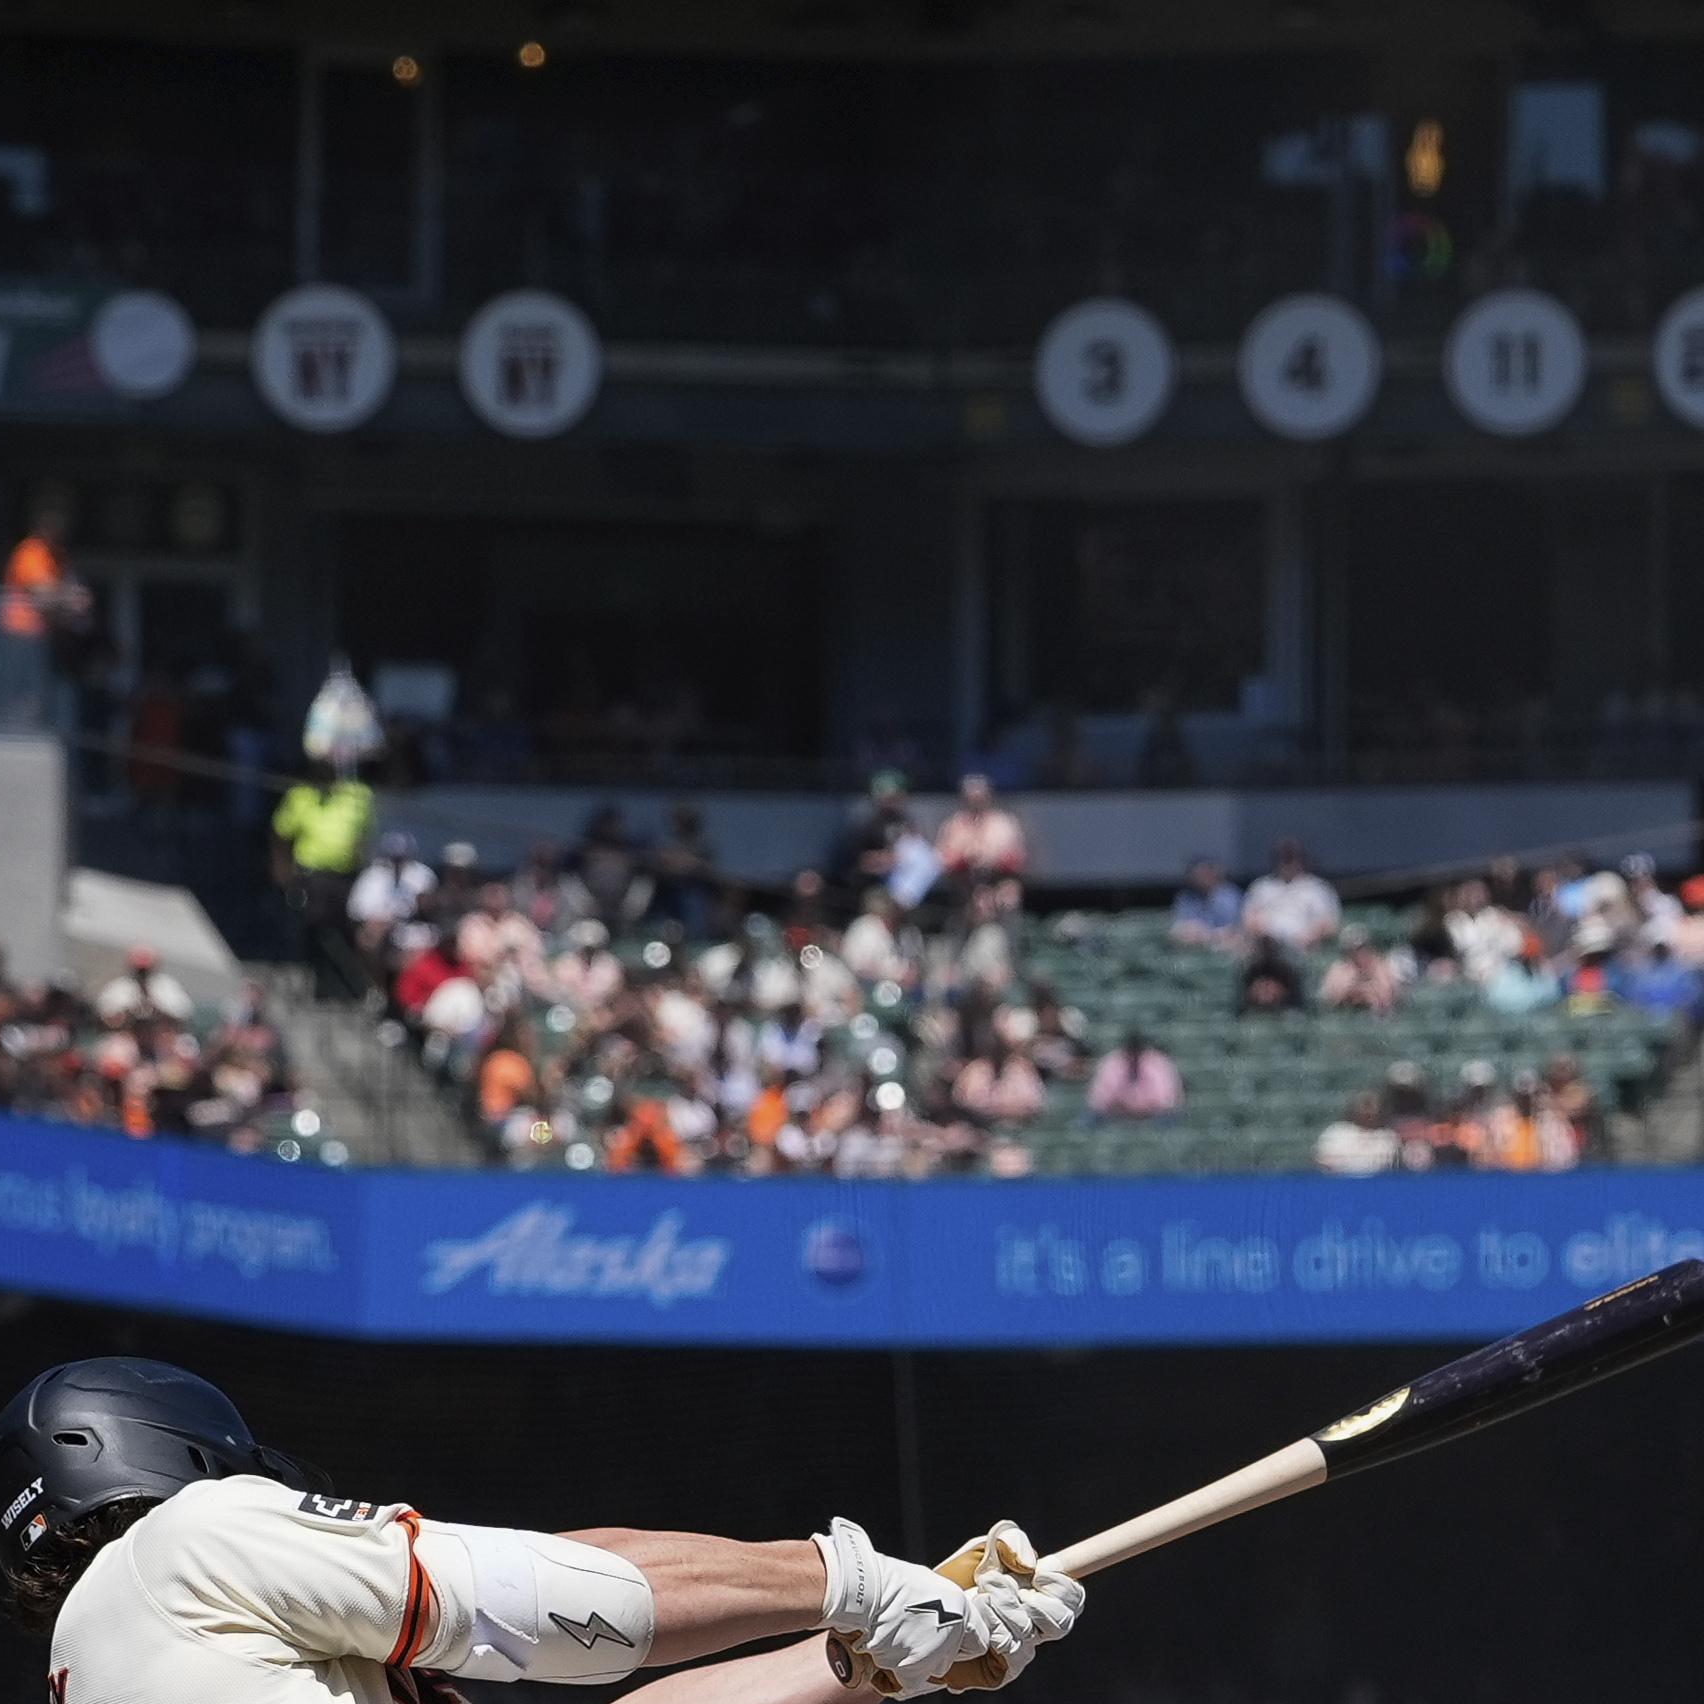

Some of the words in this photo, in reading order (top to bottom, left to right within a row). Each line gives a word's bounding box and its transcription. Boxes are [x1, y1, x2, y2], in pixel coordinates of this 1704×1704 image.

[1079, 336, 1129, 406] 3
[1281, 332, 1328, 394] 4
[1490, 330, 1543, 390] 11
[423, 1200, 731, 1311] Alaska
[1100, 1234, 1149, 1296] a
[1160, 1216, 1281, 1296] line
[1293, 1214, 1463, 1293] drive
[1474, 1221, 1551, 1291] to
[0, 1476, 45, 1531] WISELY
[856, 1574, 866, 1608] BOLT
